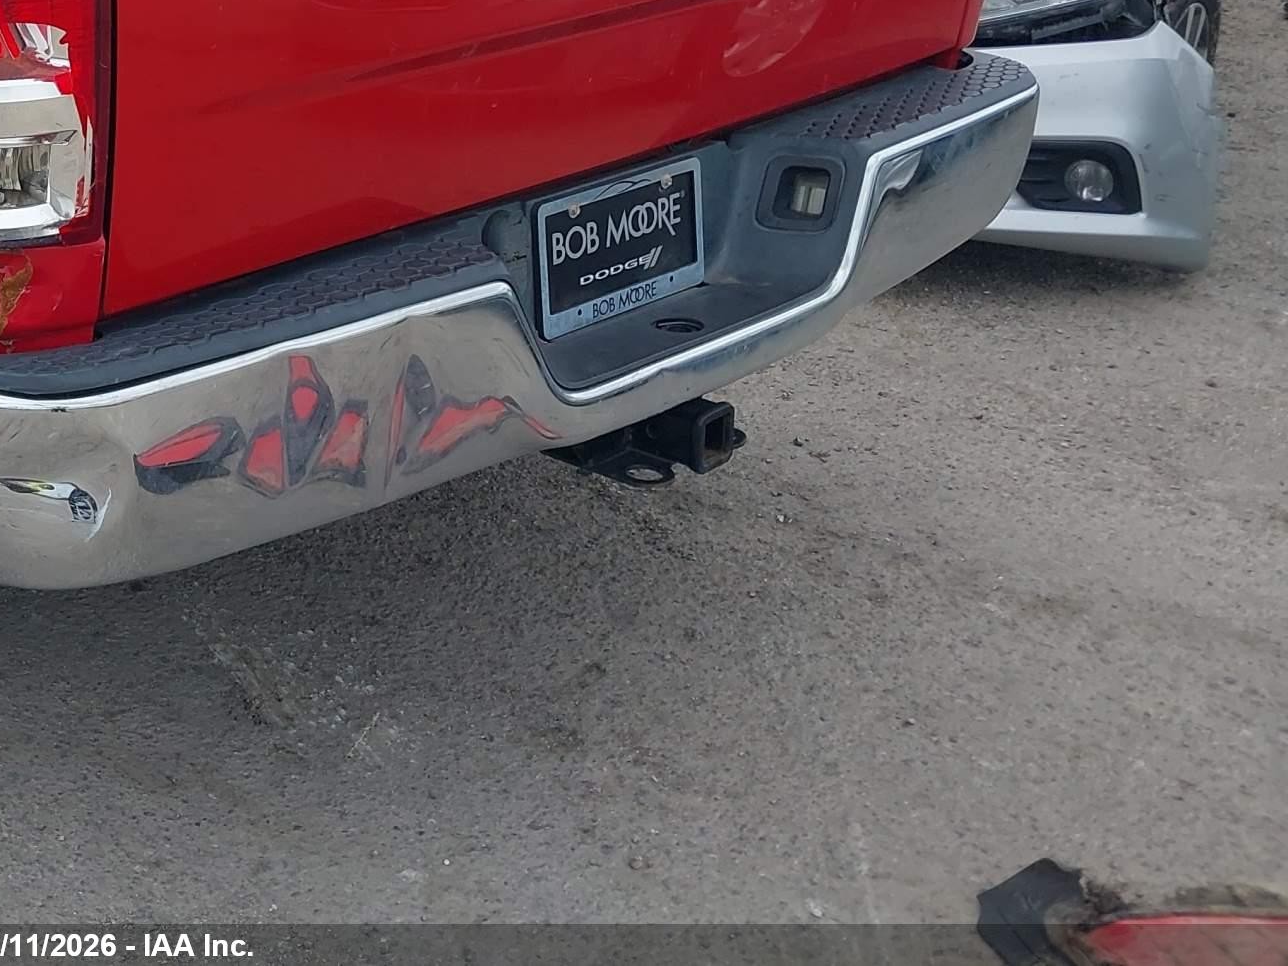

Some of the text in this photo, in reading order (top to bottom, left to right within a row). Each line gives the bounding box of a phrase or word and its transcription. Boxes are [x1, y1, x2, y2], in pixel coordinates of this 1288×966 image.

[552, 192, 681, 266] BOB MOORE
[579, 255, 651, 286] DODGE
[592, 281, 657, 319] BOB MOORE
